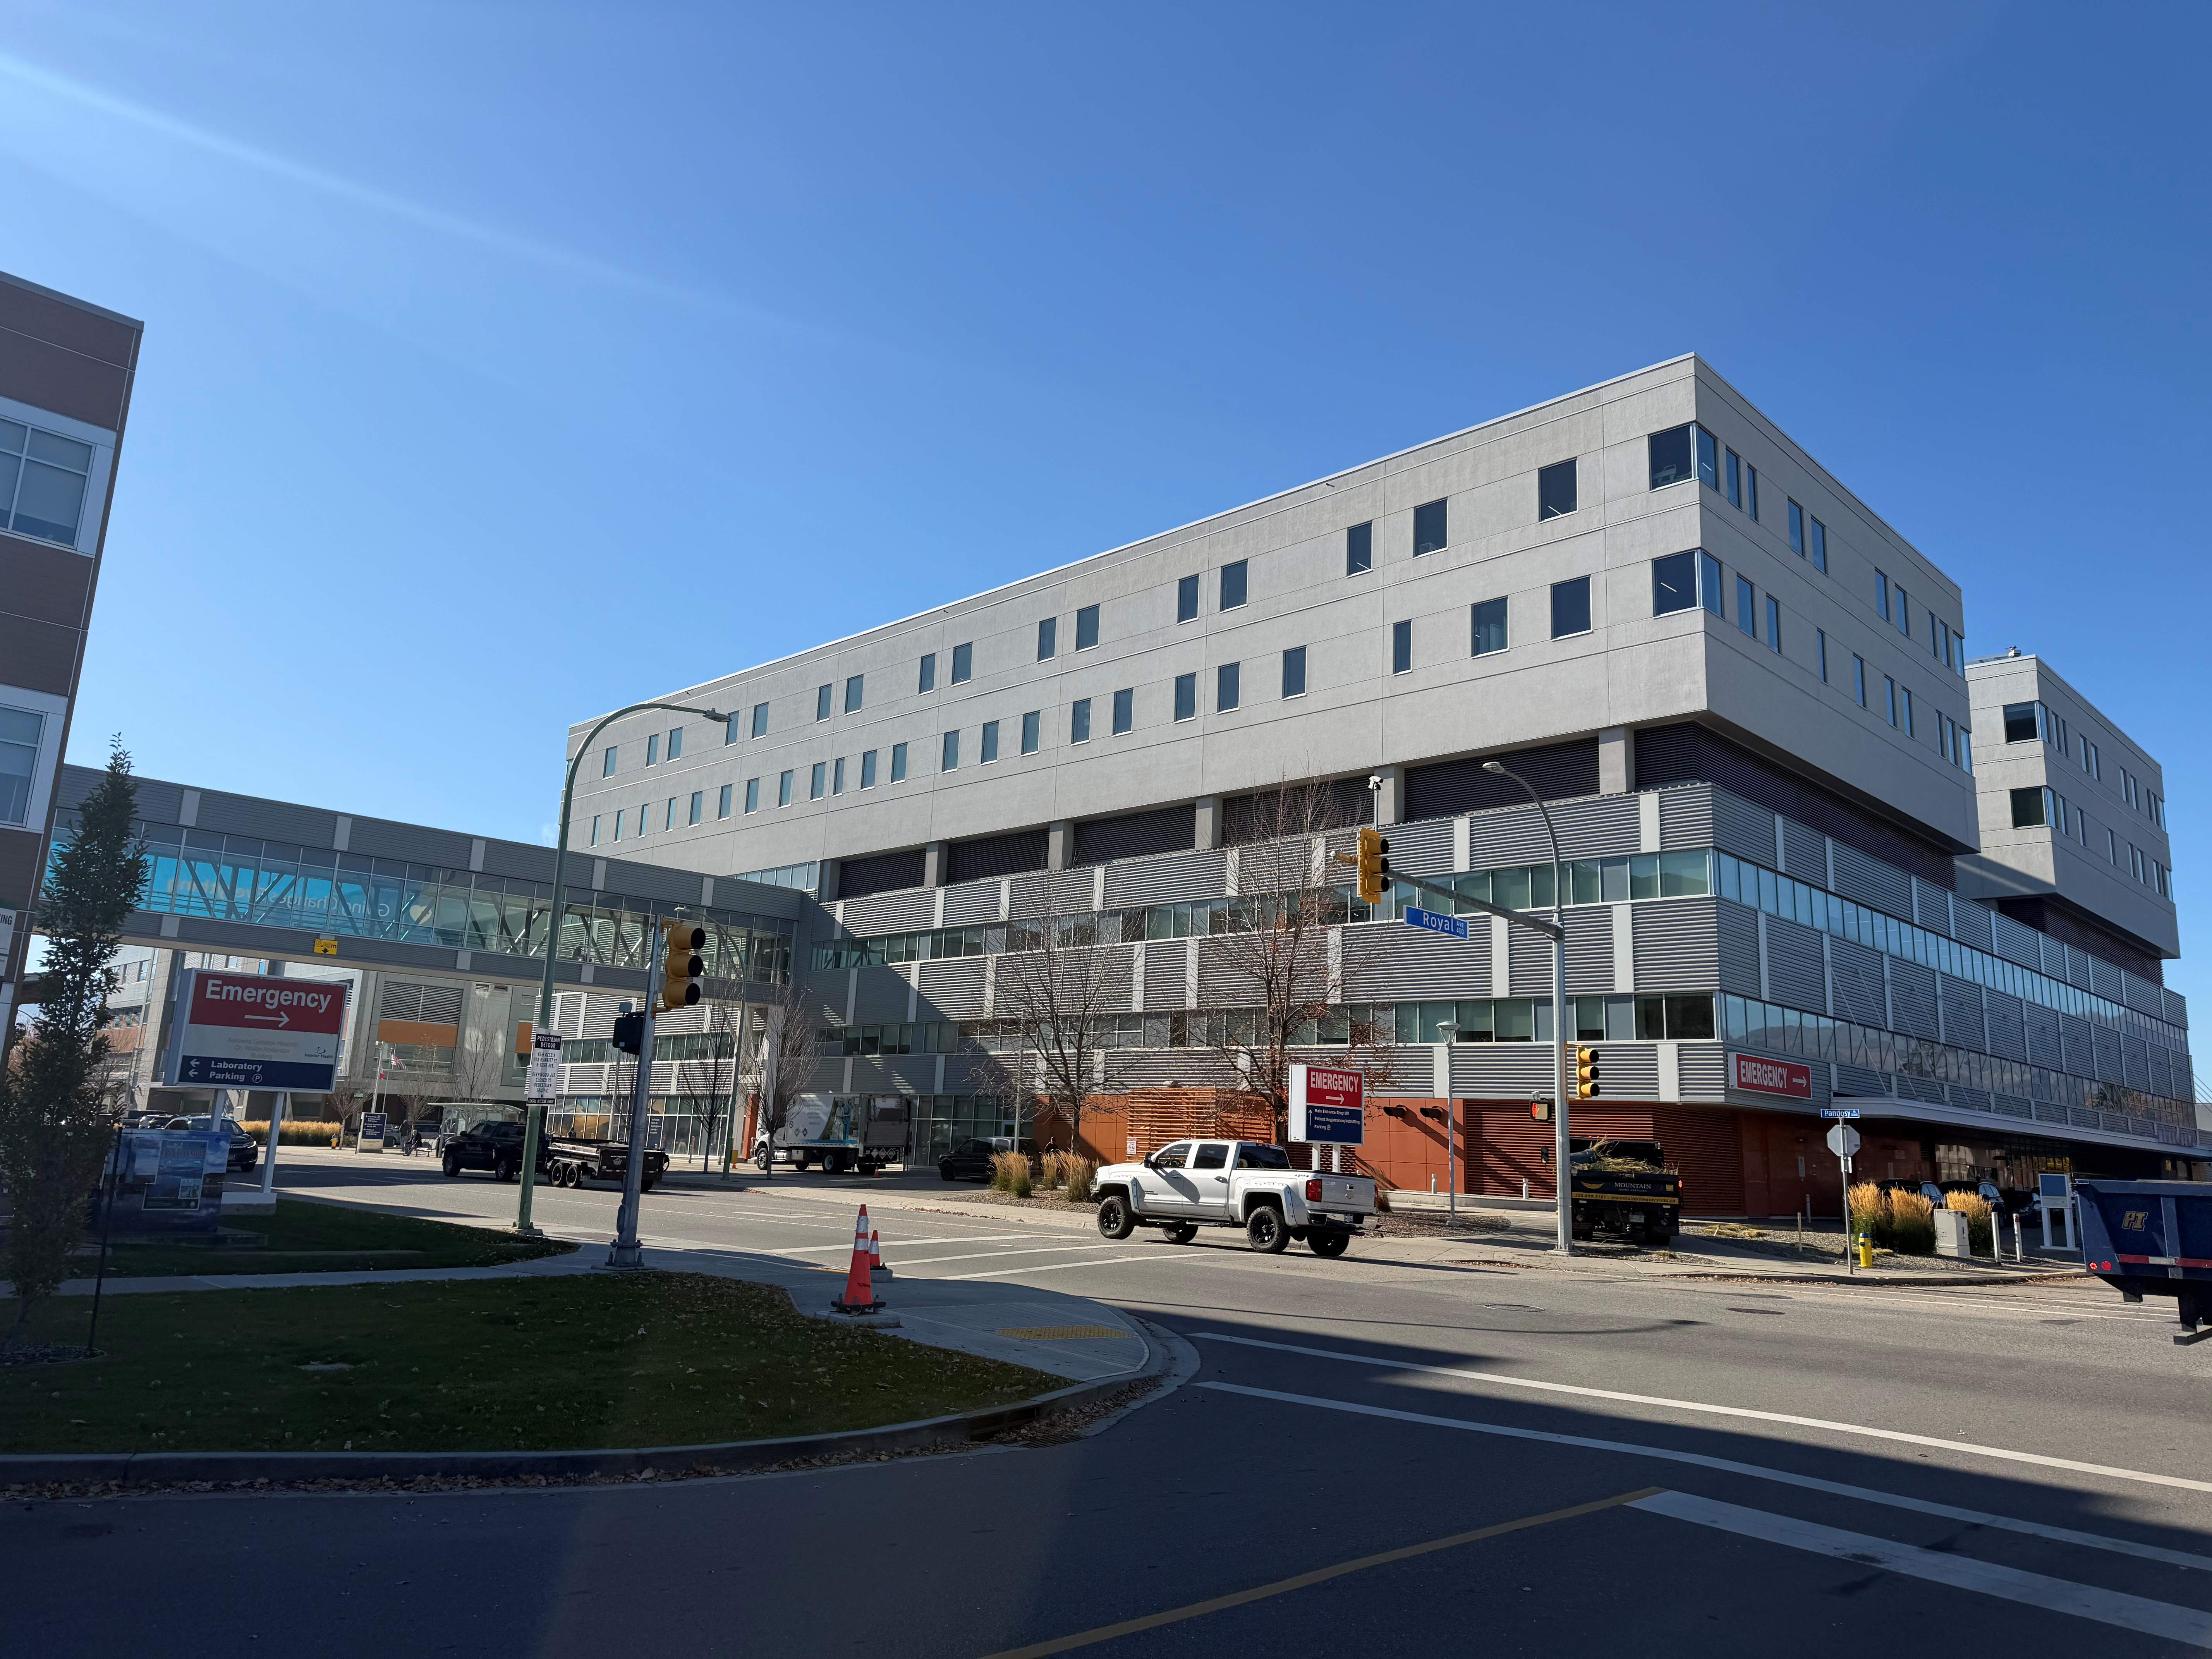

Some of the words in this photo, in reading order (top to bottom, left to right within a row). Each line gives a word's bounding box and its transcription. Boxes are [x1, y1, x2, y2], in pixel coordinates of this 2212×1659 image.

[0, 914, 12, 925] ING
[1423, 912, 1454, 932] Royal
[206, 979, 331, 1013] Emergency
[210, 1071, 245, 1082] Parking
[211, 1061, 262, 1072] Laboratory
[1740, 1060, 1787, 1088] EMERGENCY
[1310, 1072, 1358, 1092] EMERGENCY
